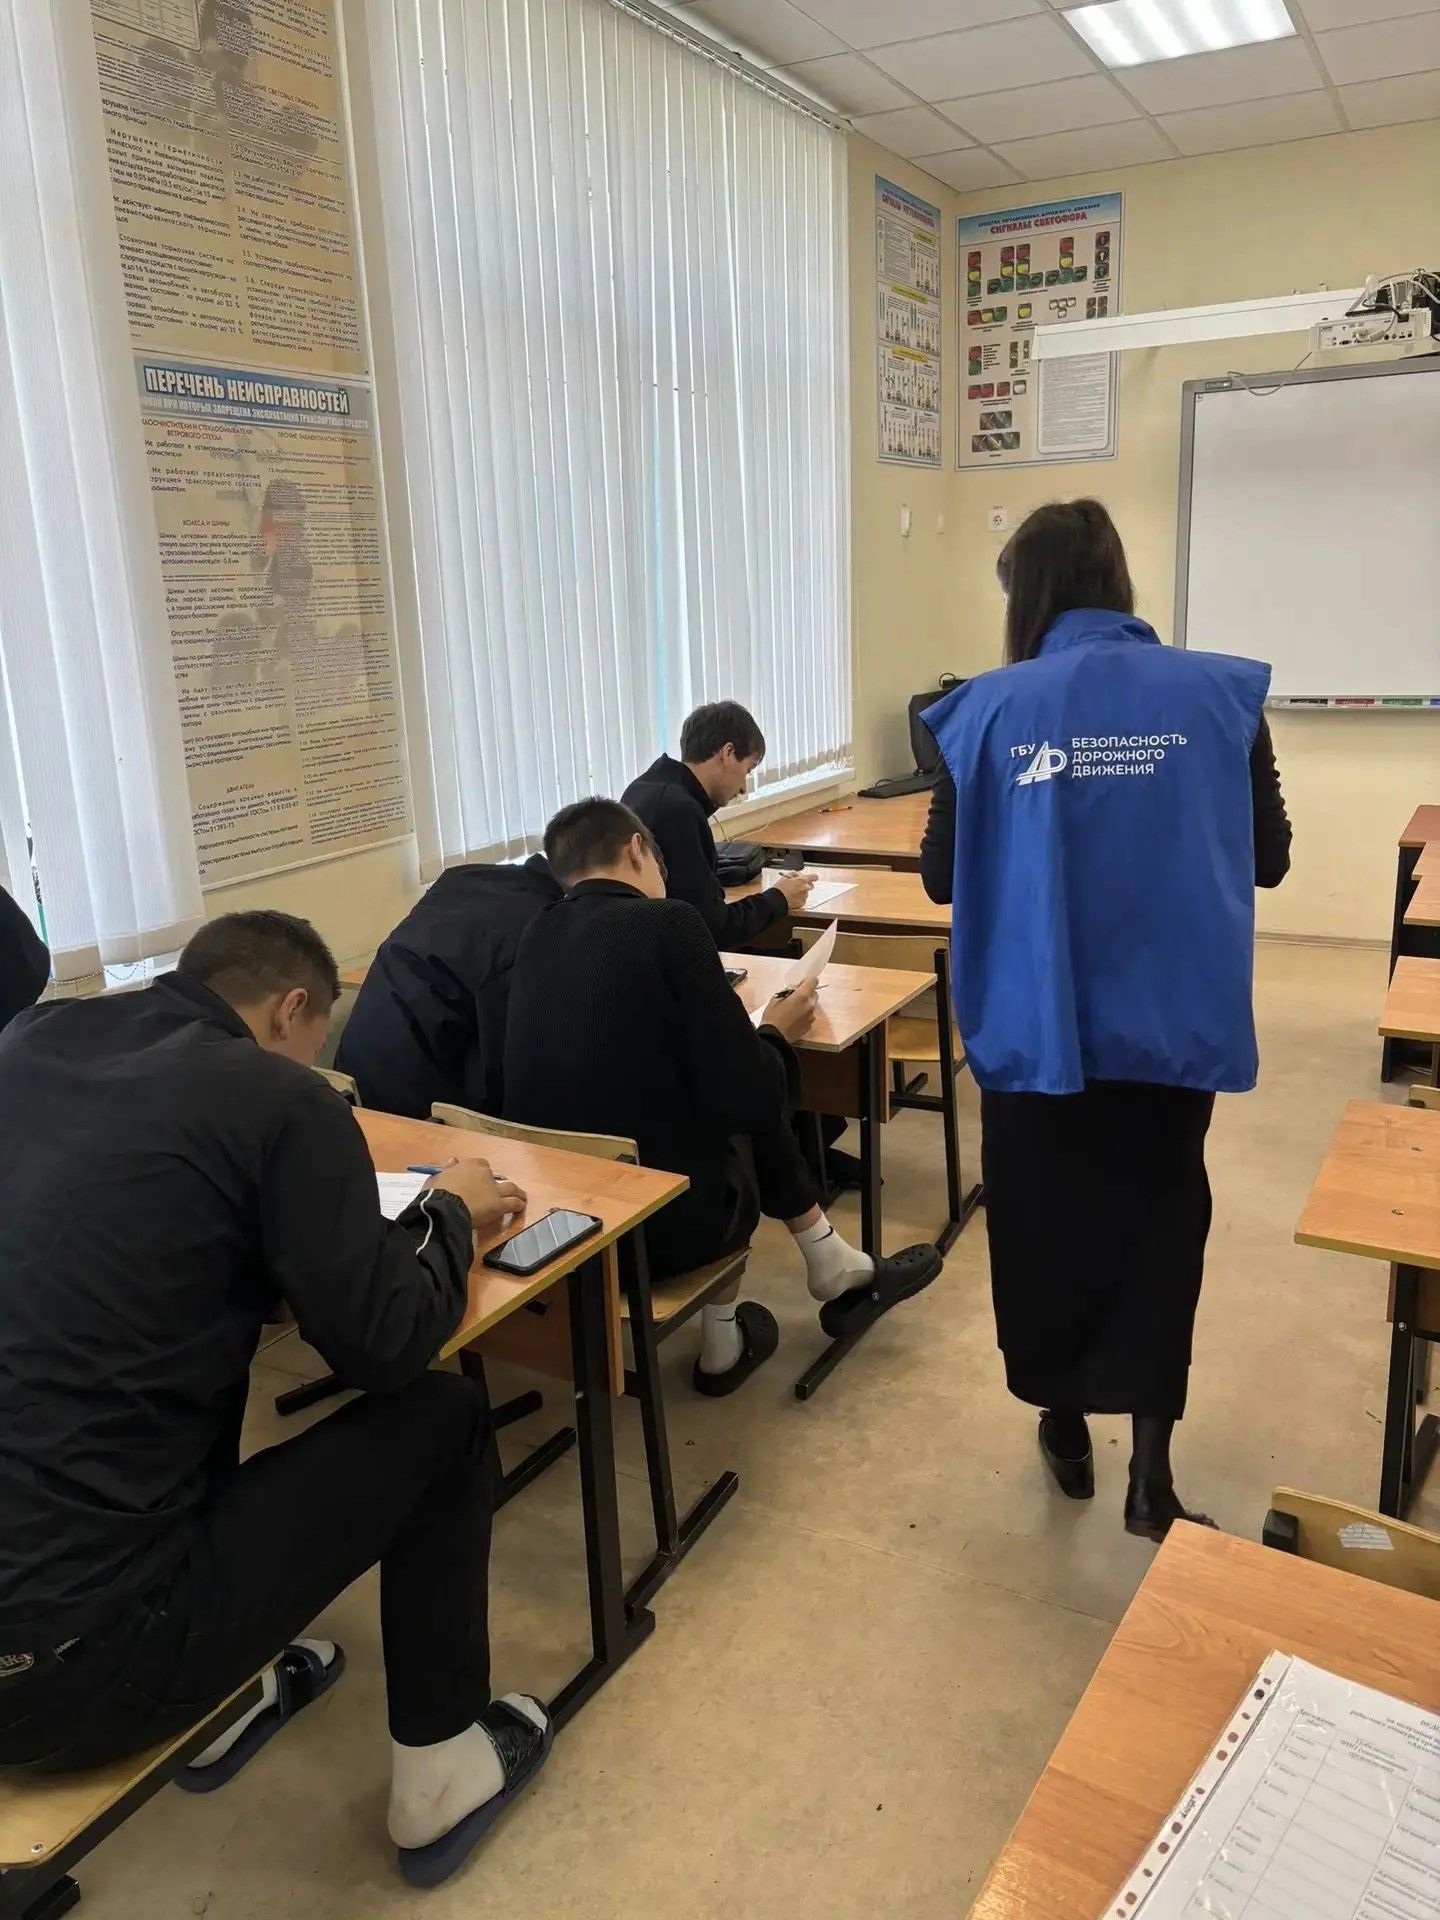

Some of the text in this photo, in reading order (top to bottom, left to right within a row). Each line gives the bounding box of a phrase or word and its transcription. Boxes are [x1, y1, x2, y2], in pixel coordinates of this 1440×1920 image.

[990, 212, 1087, 234] СИГНАЛЫ СВЕТОФОРА
[144, 368, 349, 413] ПЕРЕЧЕНЬ НЕИСПРАВНОСТЕЙ
[1072, 734, 1187, 748] БЕЗОПАСНОСТЬ
[1010, 744, 1036, 758] ГБУ
[1072, 749, 1165, 764] ДОРОЖНОГО
[1072, 764, 1154, 778] ДВИЖЕНИЯ
